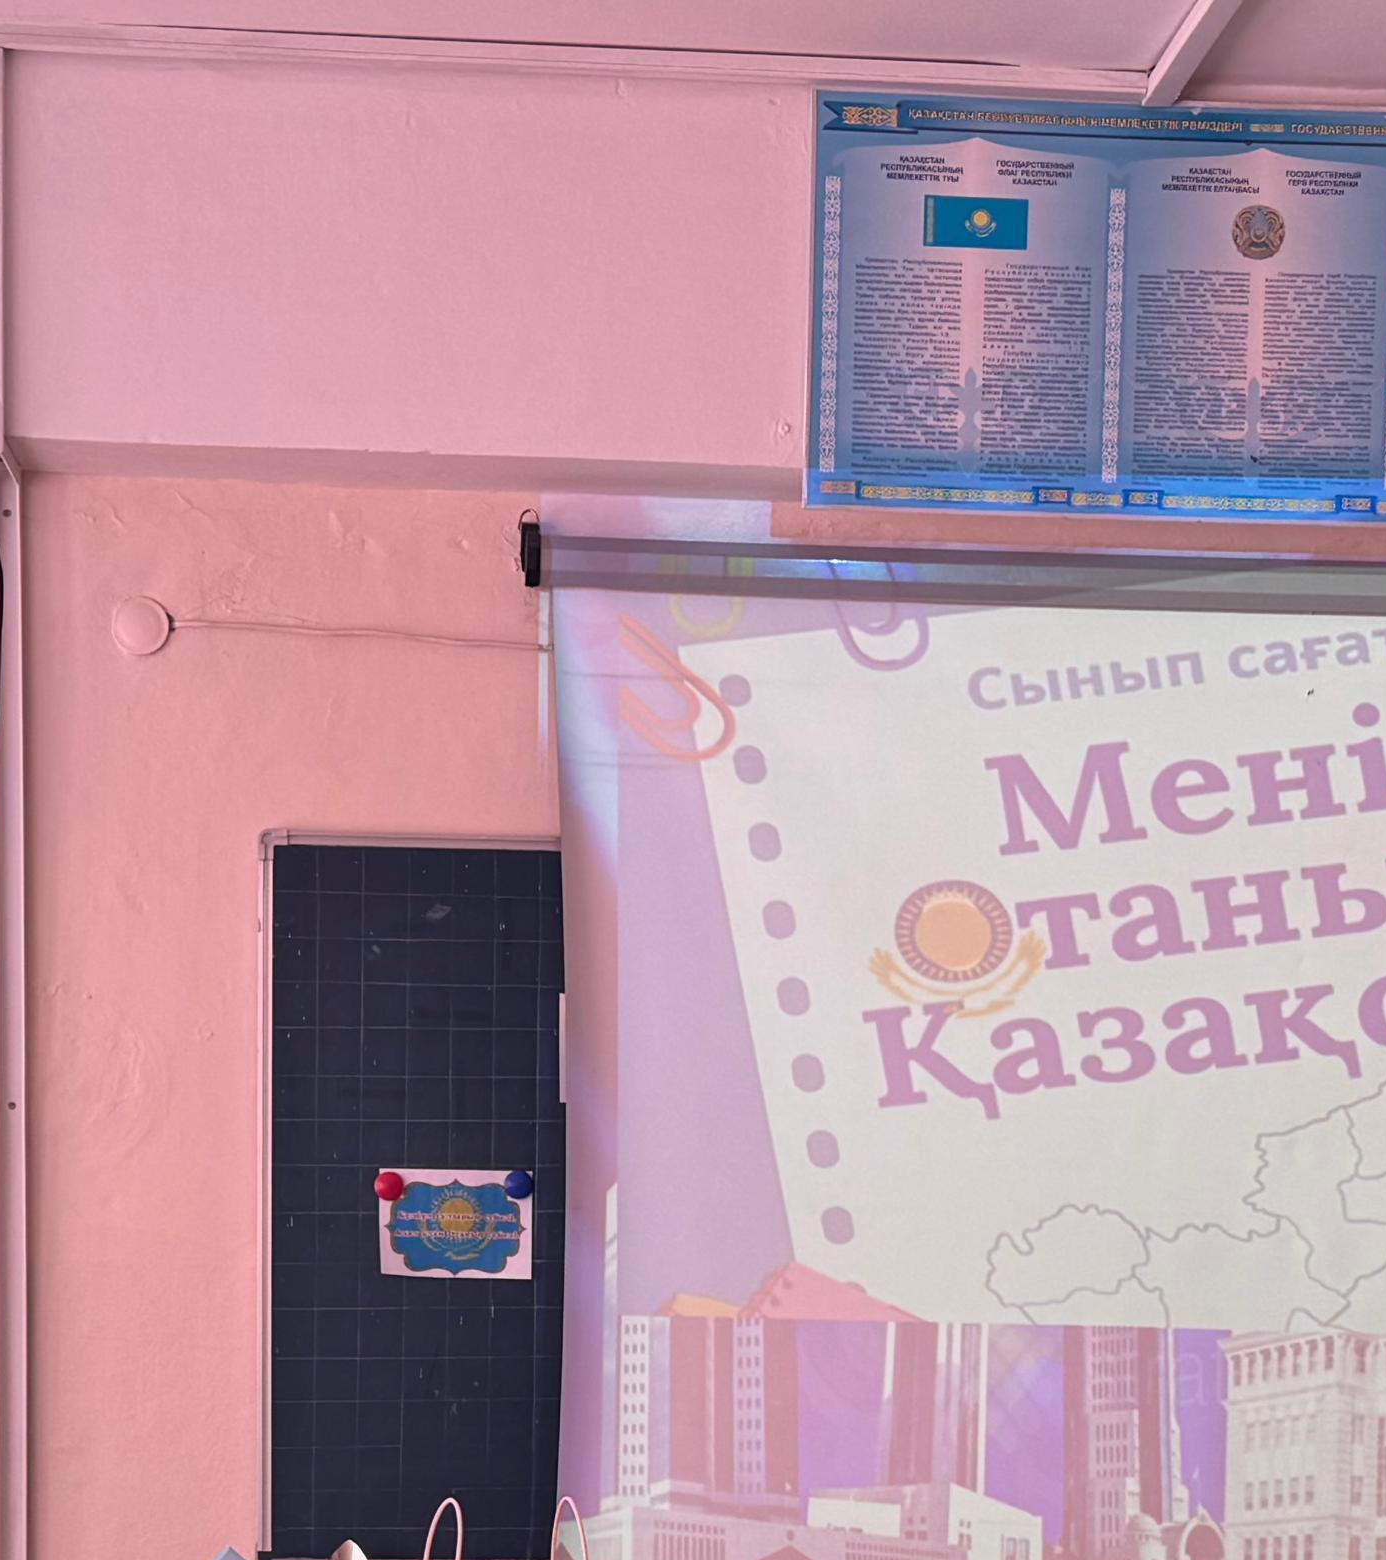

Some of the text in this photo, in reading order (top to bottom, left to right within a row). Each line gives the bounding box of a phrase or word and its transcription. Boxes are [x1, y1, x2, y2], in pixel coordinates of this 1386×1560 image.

[996, 160, 1074, 170] ГОСУДАРСТВЕННЫЙ
[1020, 169, 1072, 178] РЕСПУБЛИКИ
[1285, 170, 1362, 180] ГОСУДАРСТВЕННЫЙ
[1012, 178, 1057, 187] КАЗАХСТАН
[1287, 178, 1359, 188] ГЕРБ РЕСПУБЛИКИ
[1301, 187, 1345, 196] КАЗАХСТАН
[966, 650, 1206, 711] Сынып
